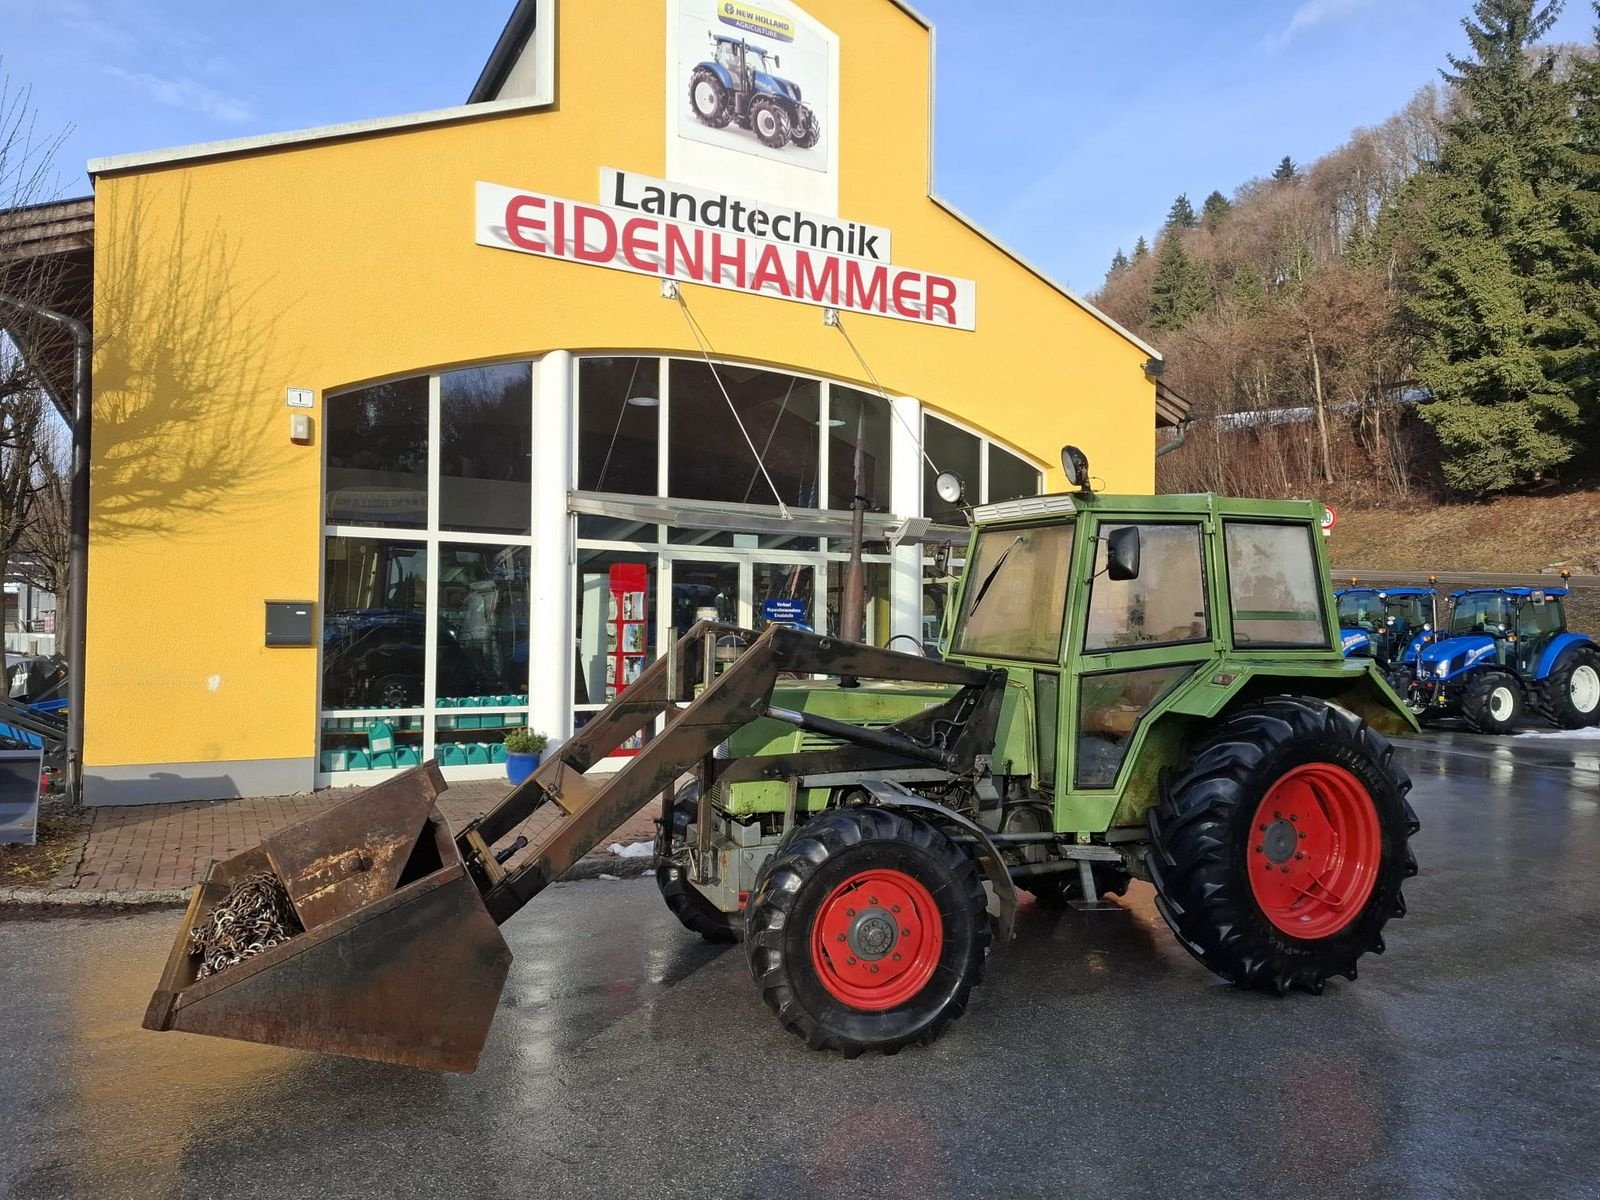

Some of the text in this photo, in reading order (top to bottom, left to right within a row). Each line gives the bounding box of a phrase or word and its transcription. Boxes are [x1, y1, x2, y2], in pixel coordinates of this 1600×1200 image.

[735, 20, 777, 38] AGRICULTURE
[736, 8, 789, 31] NEW HOLLAND
[615, 172, 880, 259] Landtechnik
[505, 195, 957, 325] EIDENHAMMER
